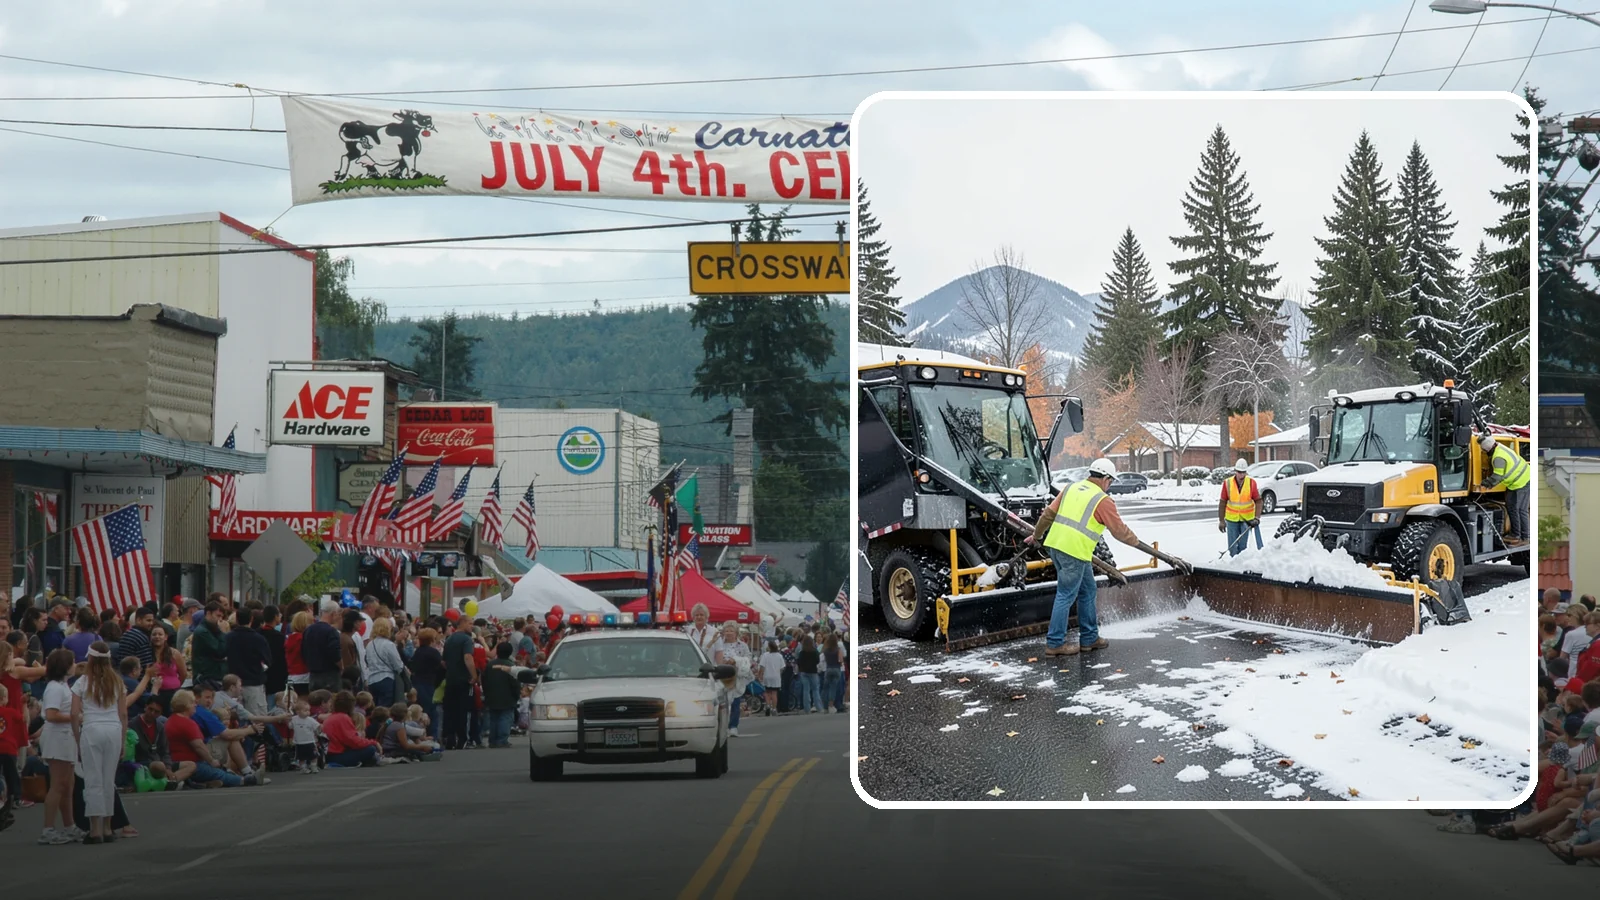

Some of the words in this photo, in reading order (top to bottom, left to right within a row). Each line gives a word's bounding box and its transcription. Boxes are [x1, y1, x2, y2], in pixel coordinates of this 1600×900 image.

[695, 121, 850, 149] Carnat
[481, 141, 605, 193] JULY
[632, 149, 746, 198] 4th.
[697, 254, 850, 280] CROSSWA
[282, 380, 374, 420] ACE
[406, 409, 452, 422] CEDAR
[461, 409, 485, 422] LOG
[283, 421, 371, 437] Hardware
[353, 467, 384, 480] Simpl
[83, 485, 94, 495] St.
[96, 485, 124, 495] Vincent
[126, 486, 135, 495] de
[137, 486, 155, 495] Paul
[81, 503, 153, 522] THRT
[212, 516, 330, 535] HARDARE
[688, 526, 741, 535] CRNATION
[699, 535, 730, 543] GLASS
